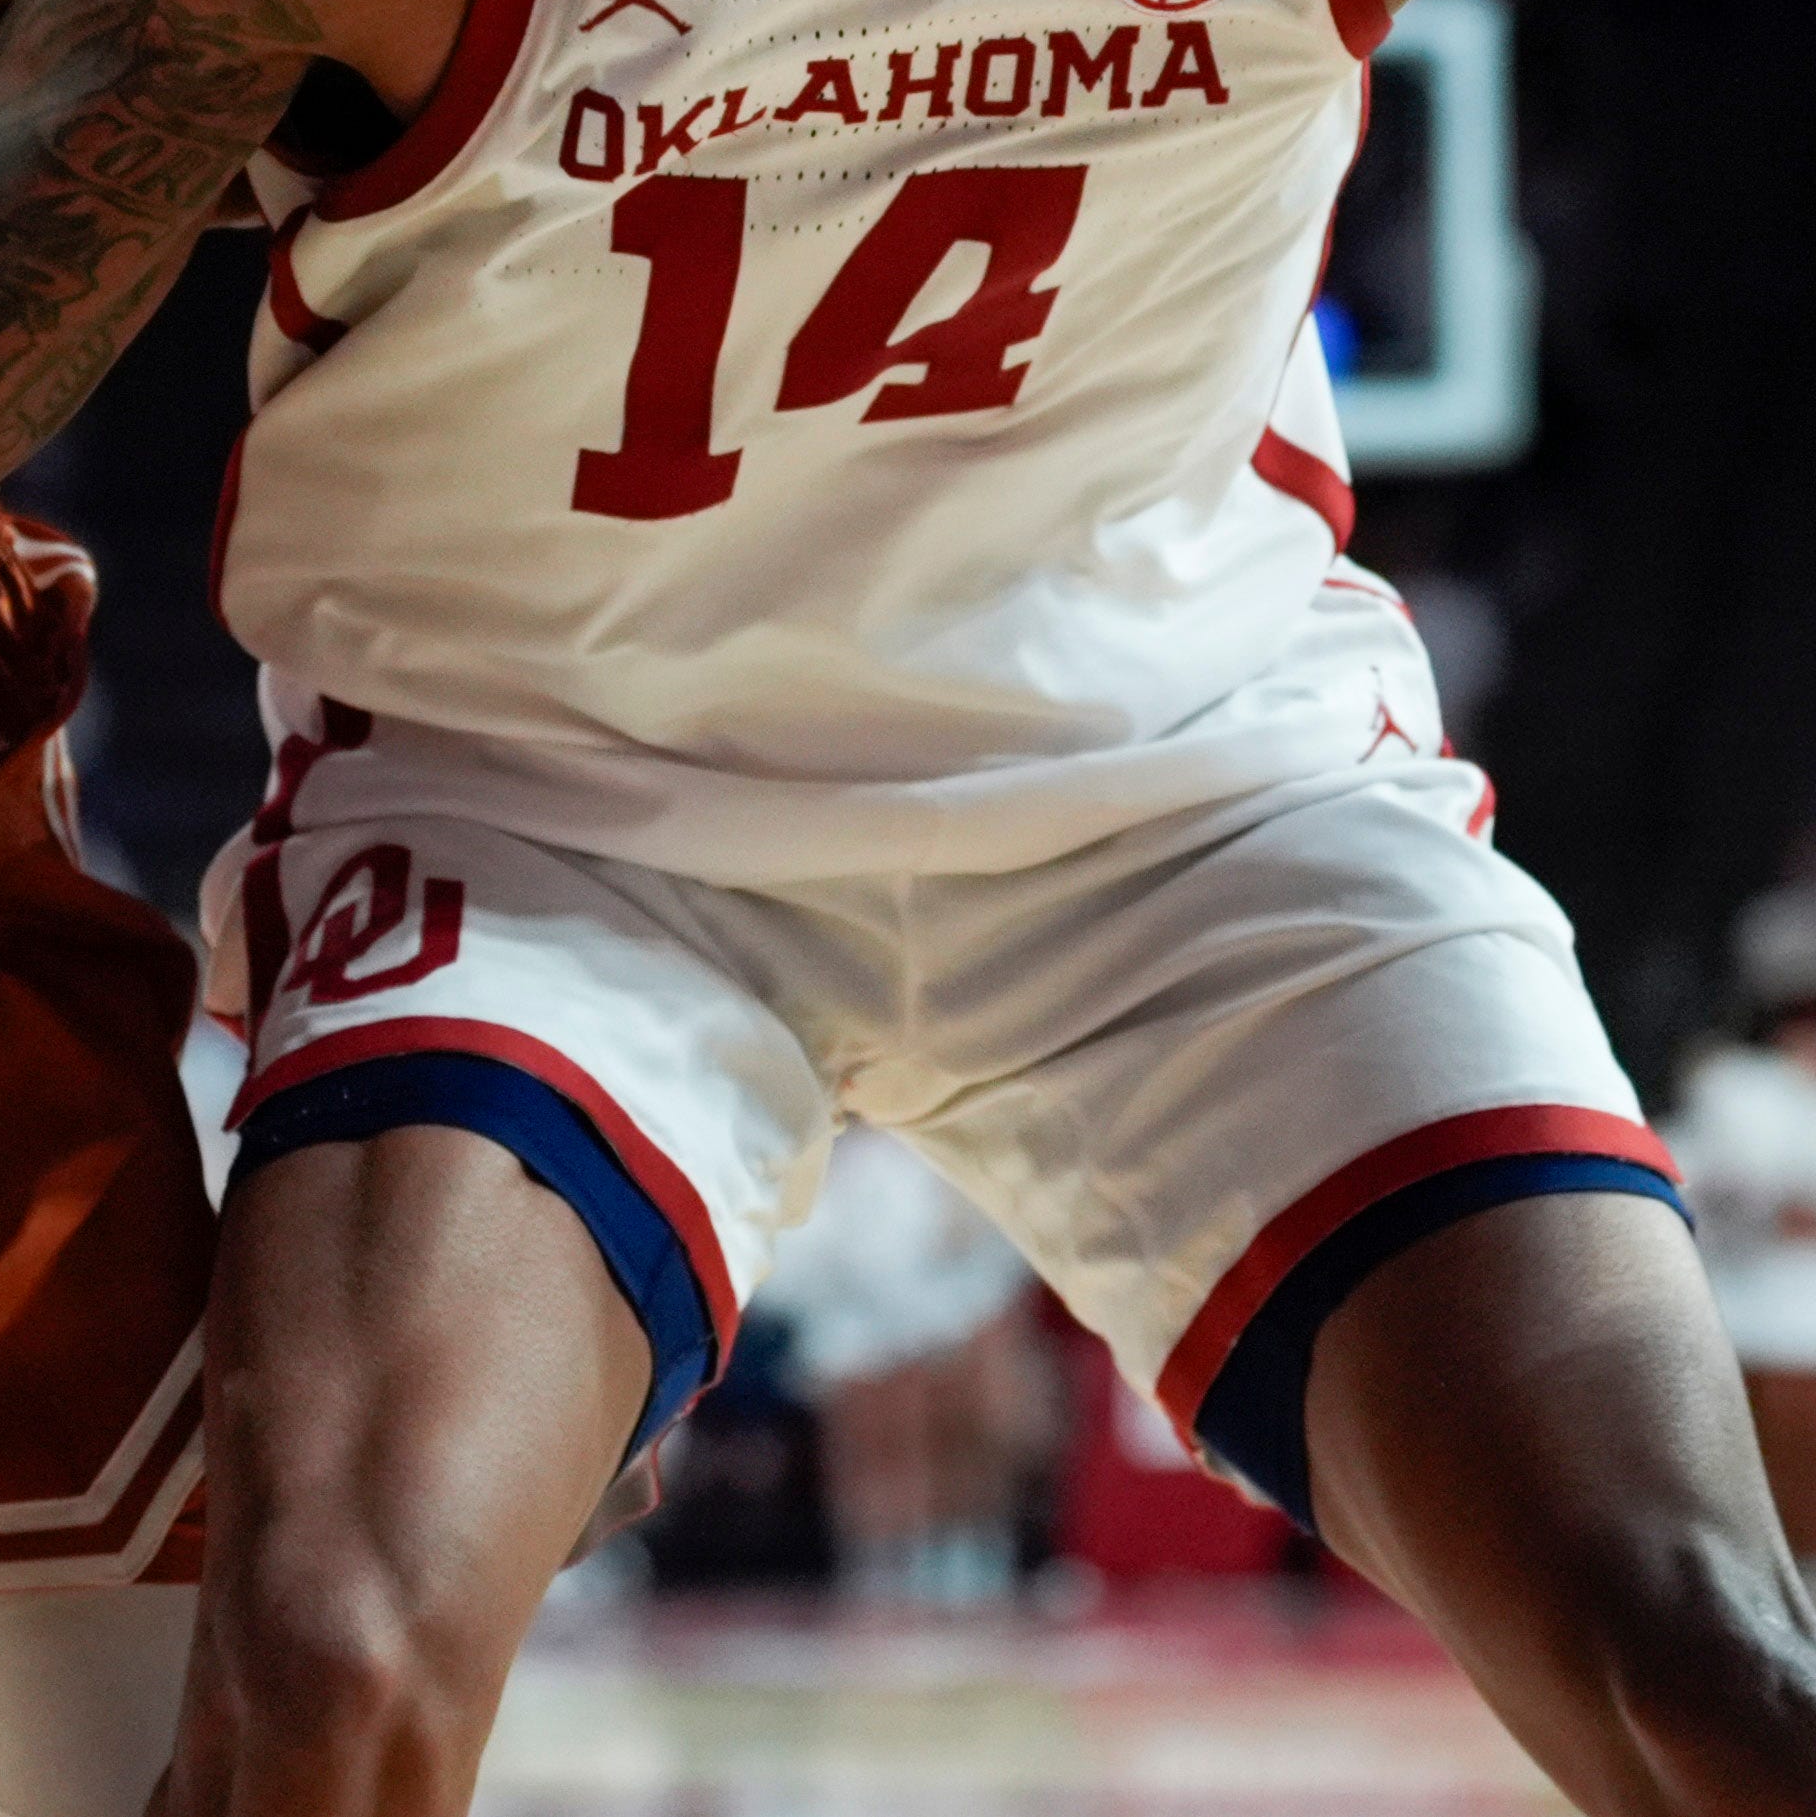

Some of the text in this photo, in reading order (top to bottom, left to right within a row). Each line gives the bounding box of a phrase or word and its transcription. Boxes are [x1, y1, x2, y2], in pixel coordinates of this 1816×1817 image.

[559, 21, 1229, 183] OKLAHOMA
[571, 164, 1089, 520] 14
[286, 843, 465, 1003] OU
